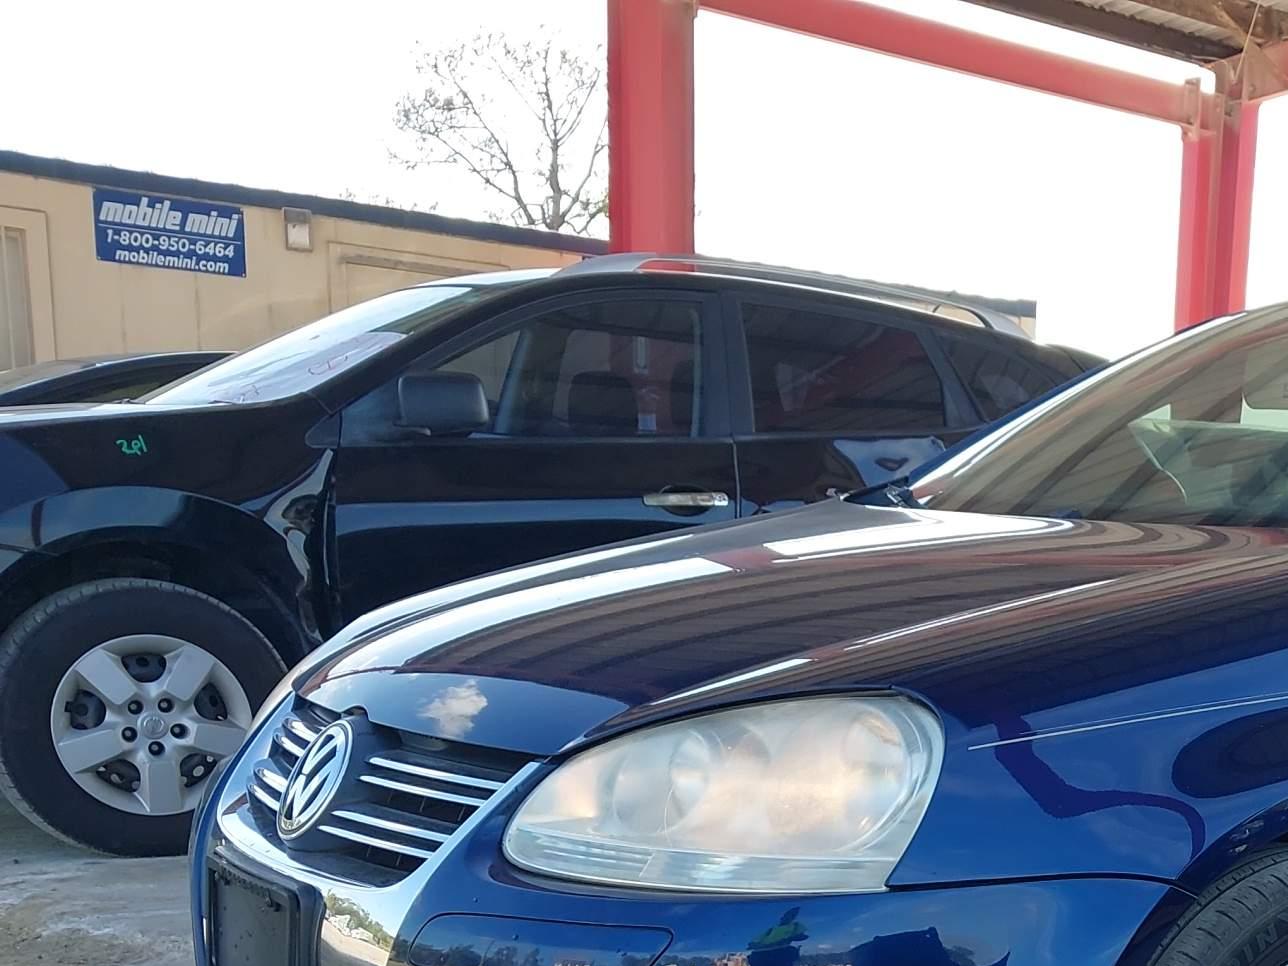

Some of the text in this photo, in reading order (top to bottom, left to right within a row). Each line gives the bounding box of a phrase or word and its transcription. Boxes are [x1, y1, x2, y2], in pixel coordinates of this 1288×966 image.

[99, 197, 239, 238] mobile mini
[106, 228, 234, 258] 1-800-950-6464
[115, 249, 229, 274] mobilemini.com
